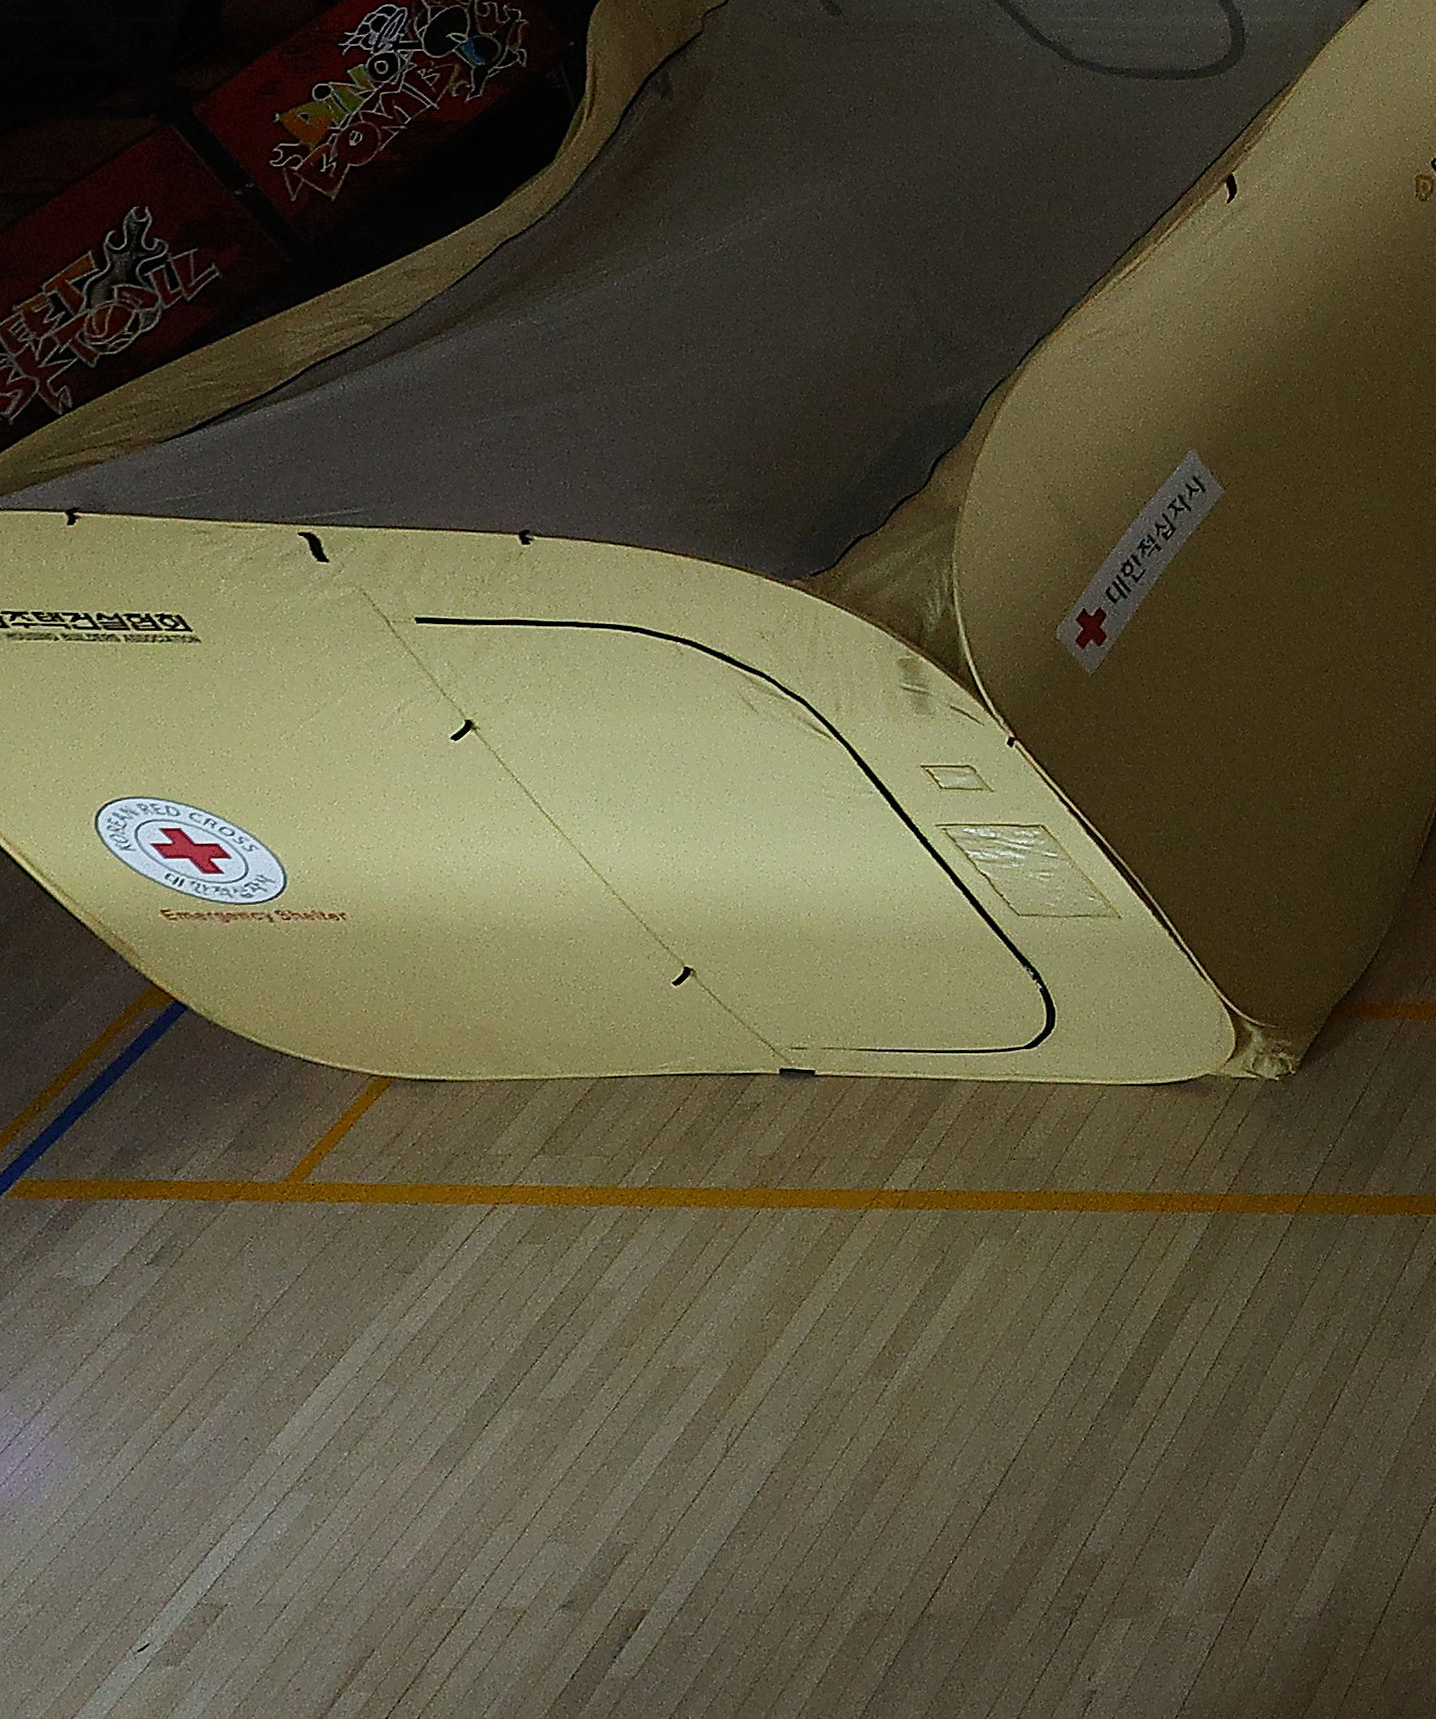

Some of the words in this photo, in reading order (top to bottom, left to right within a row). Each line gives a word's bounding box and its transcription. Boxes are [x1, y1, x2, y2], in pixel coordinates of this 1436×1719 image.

[1104, 475, 1207, 605] 대한적십자사
[0, 610, 193, 632] 주택건설협회
[136, 802, 181, 817] RED
[188, 810, 259, 853] CROSS
